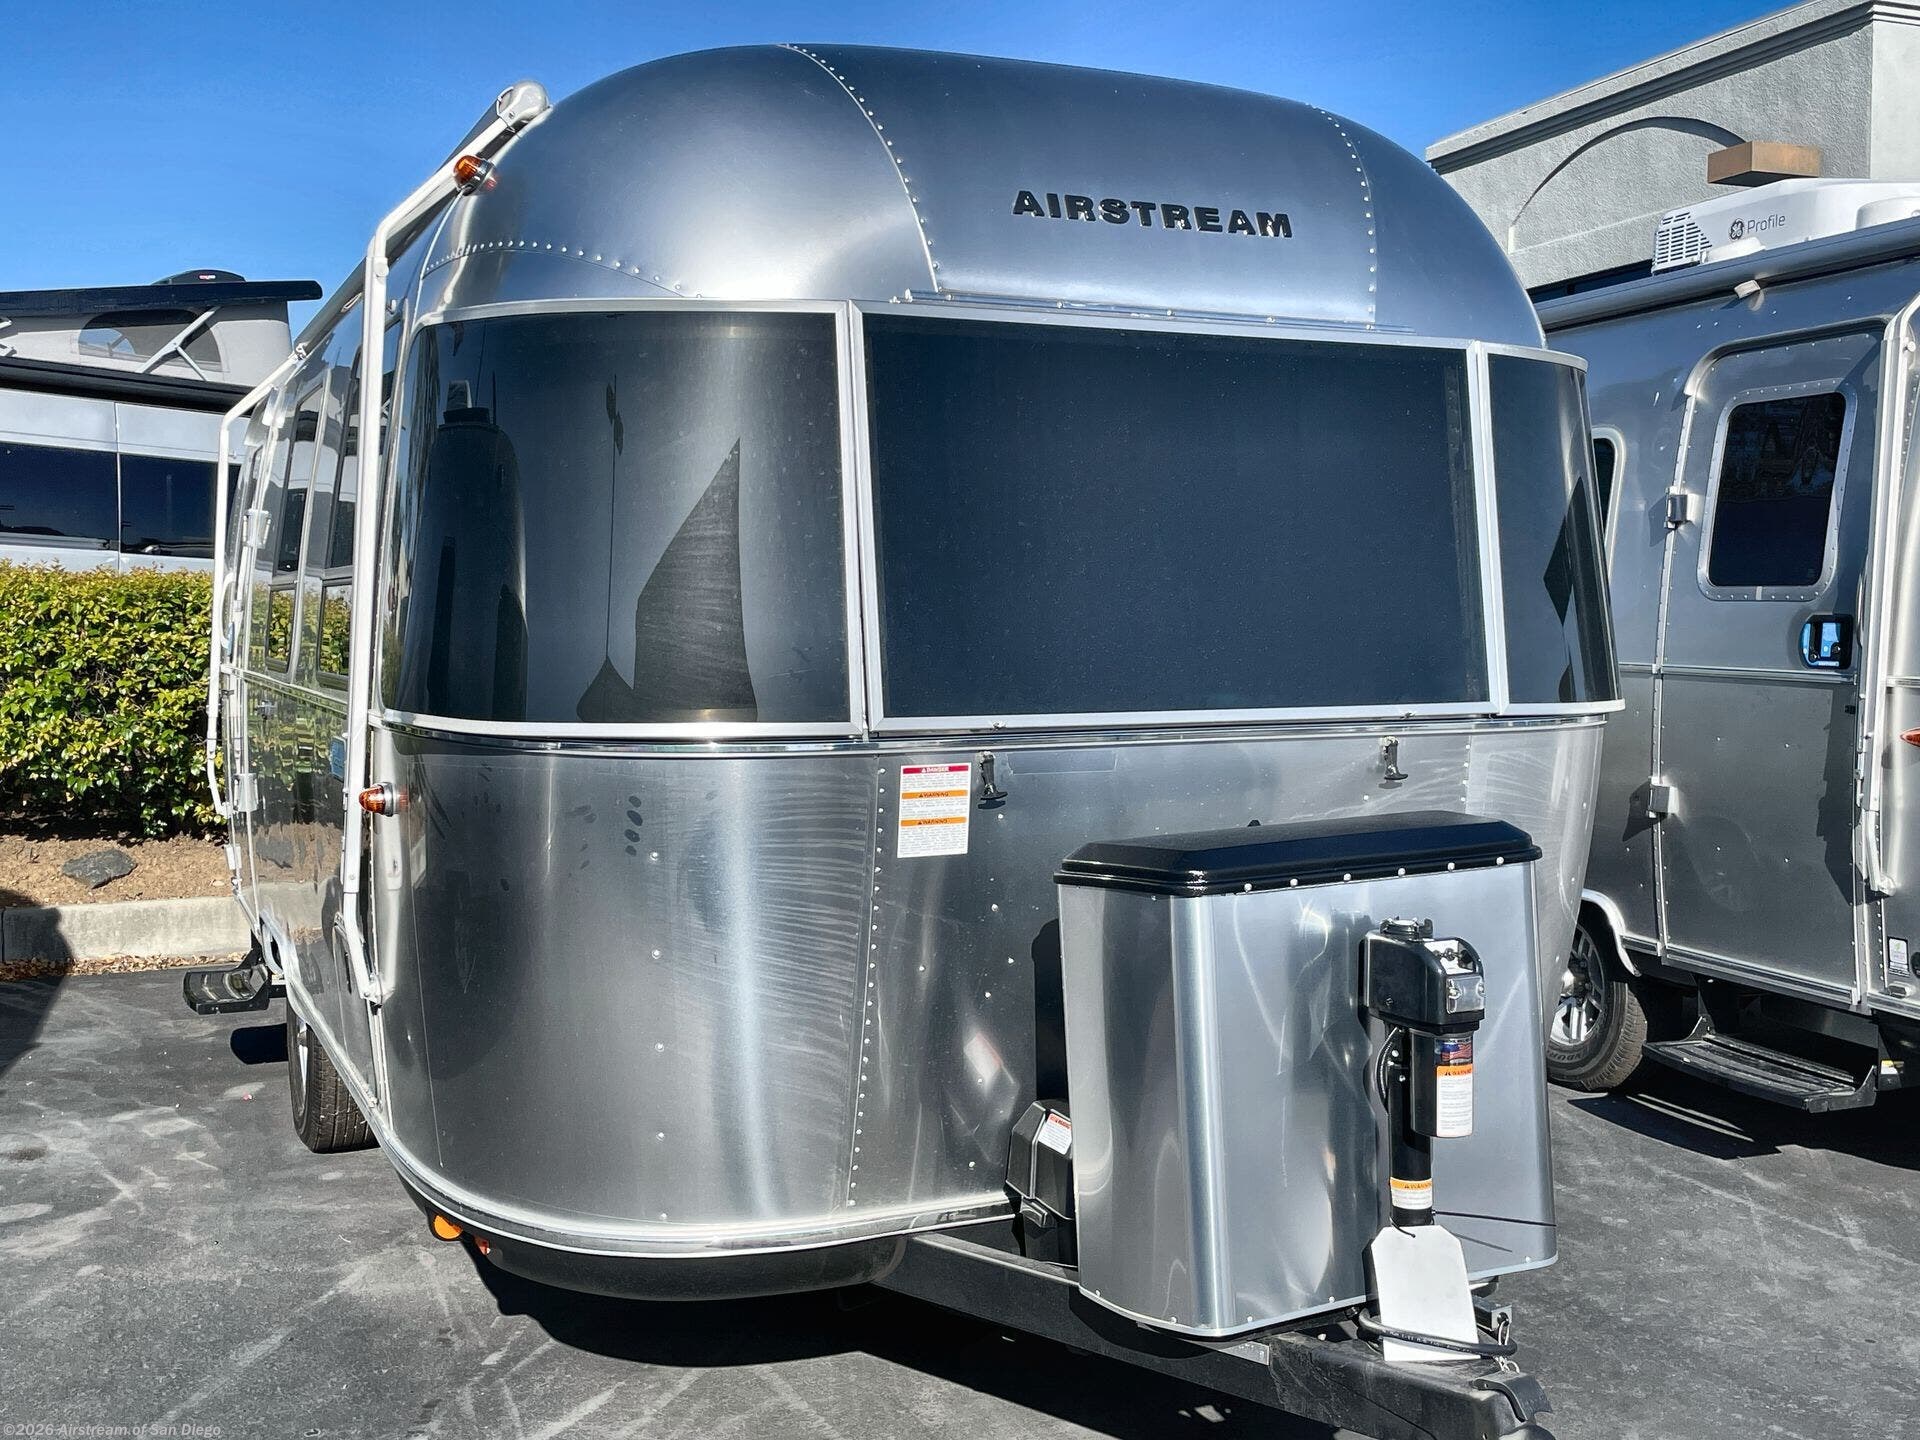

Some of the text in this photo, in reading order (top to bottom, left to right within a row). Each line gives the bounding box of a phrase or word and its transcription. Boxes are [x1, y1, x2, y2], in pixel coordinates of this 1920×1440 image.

[1012, 190, 1294, 239] AIRSTREAM
[1747, 213, 1786, 235] Profile
[923, 791, 949, 799] WARNING
[922, 818, 949, 826] WARNING
